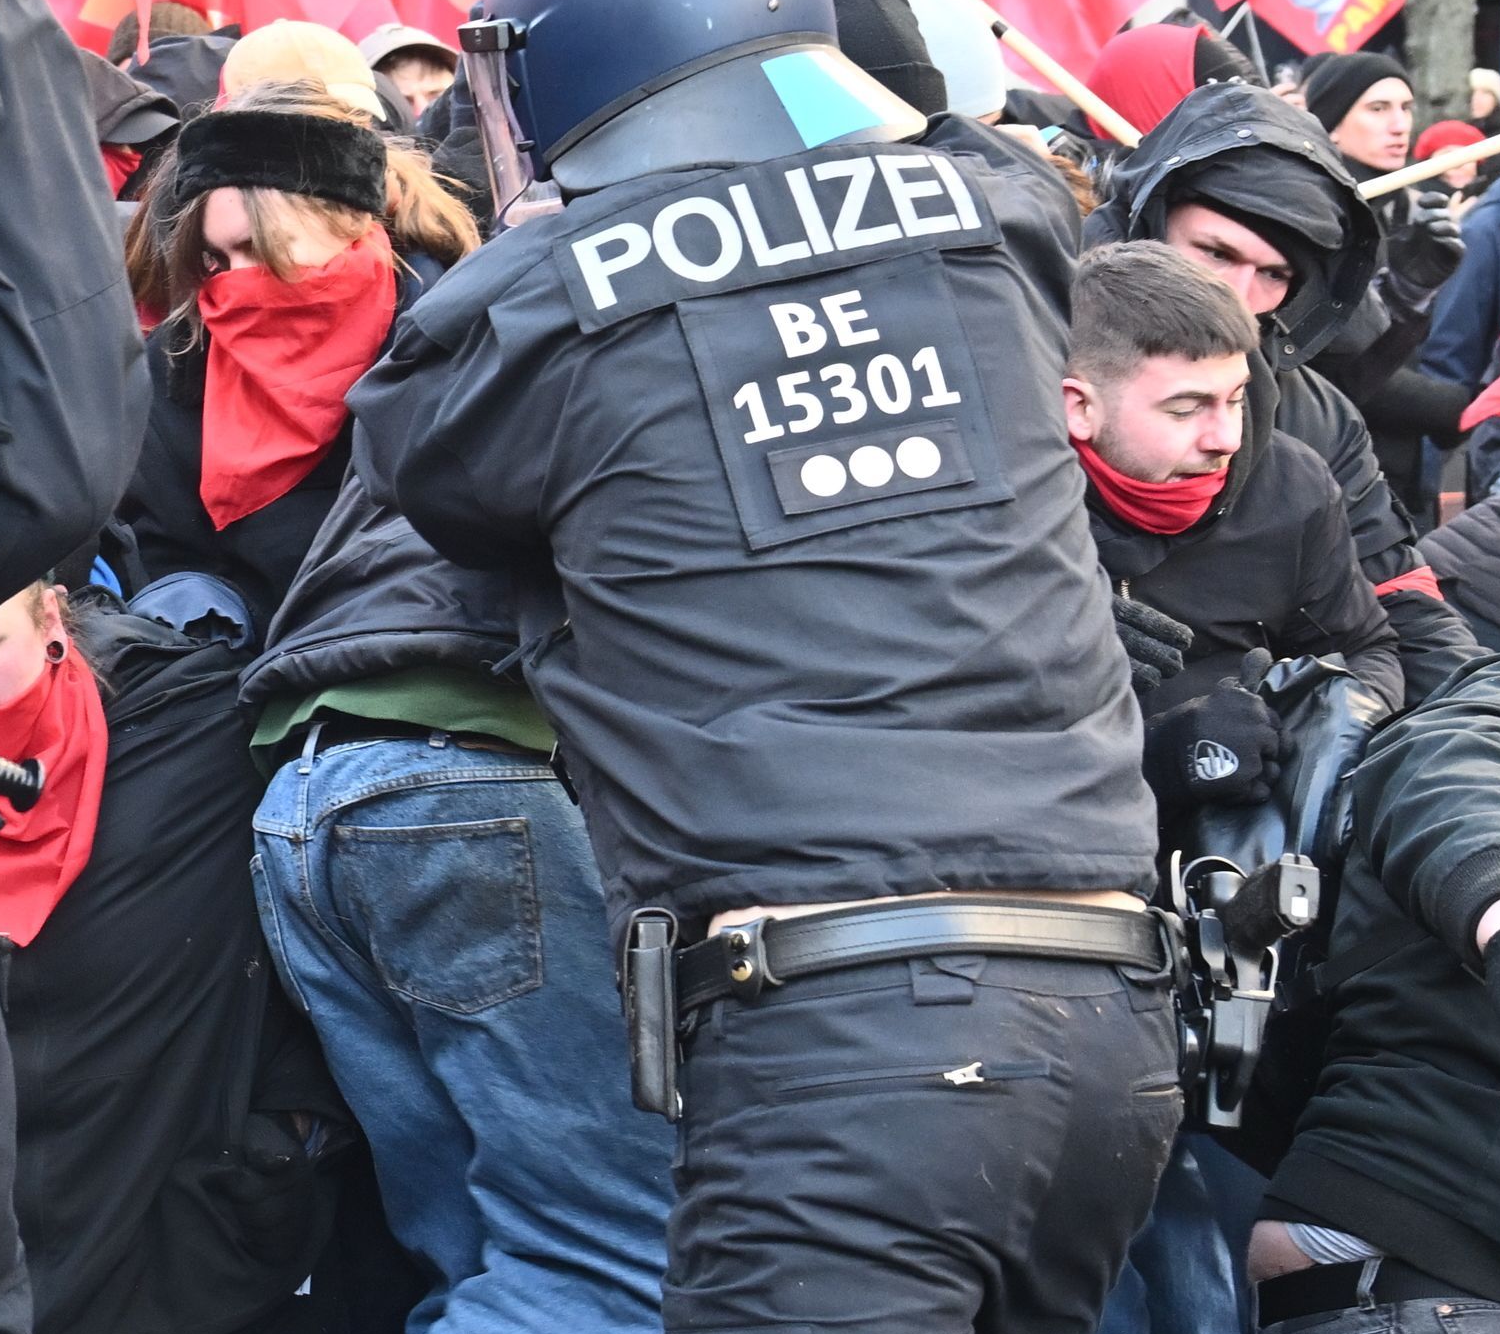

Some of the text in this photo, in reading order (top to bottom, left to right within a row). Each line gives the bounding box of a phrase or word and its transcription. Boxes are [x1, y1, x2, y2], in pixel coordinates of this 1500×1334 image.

[570, 154, 983, 311] POLIZEI
[768, 289, 881, 359] BE
[732, 345, 962, 445] 15301
